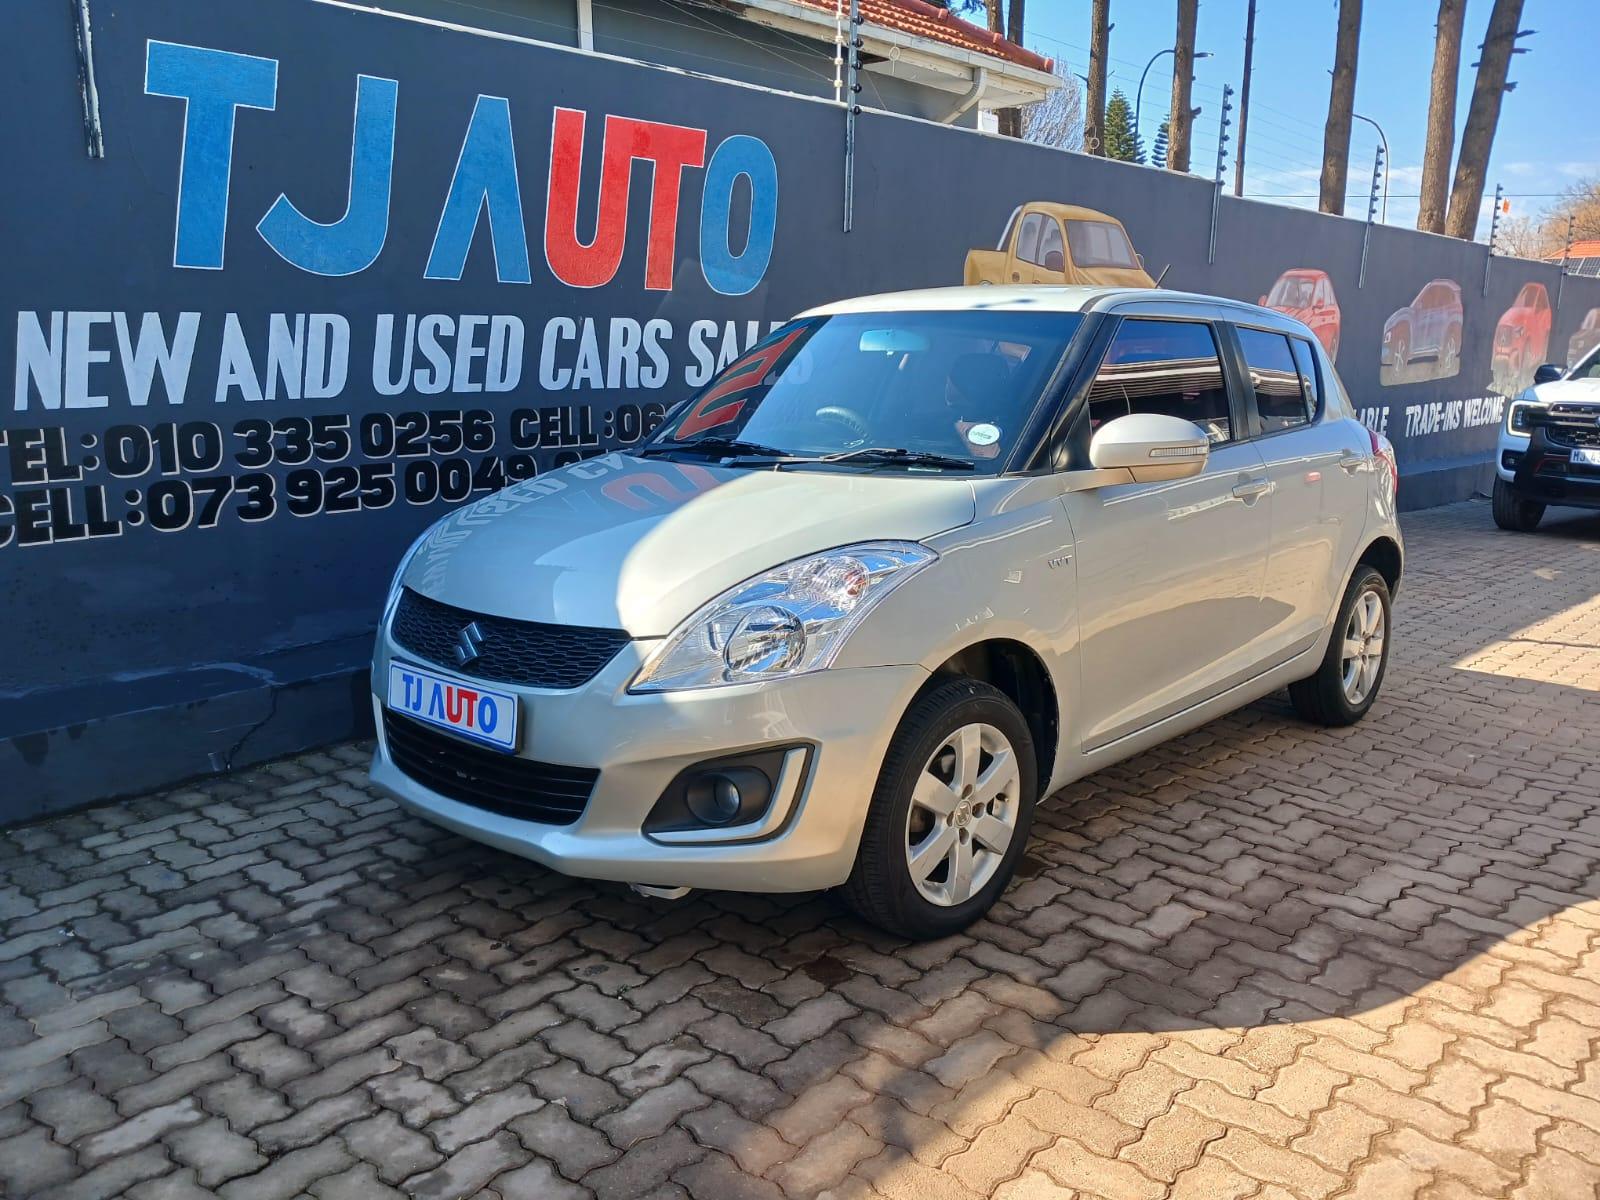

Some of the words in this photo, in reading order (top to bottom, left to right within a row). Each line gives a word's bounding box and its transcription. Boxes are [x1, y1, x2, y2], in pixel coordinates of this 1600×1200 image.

[144, 38, 399, 277] TJ
[423, 94, 779, 296] AUTO
[14, 310, 201, 411] NEW
[215, 312, 350, 402] AND
[372, 313, 525, 396] USED
[538, 316, 673, 391] CARS
[0, 419, 223, 486] EL:010
[233, 413, 351, 469] 335
[360, 408, 496, 460] 0256
[1405, 400, 1462, 438] TRADE-INS
[1463, 396, 1506, 428] WELCOME
[286, 462, 396, 518] 925
[402, 673, 423, 712] TJ
[428, 682, 498, 734] AUTO
